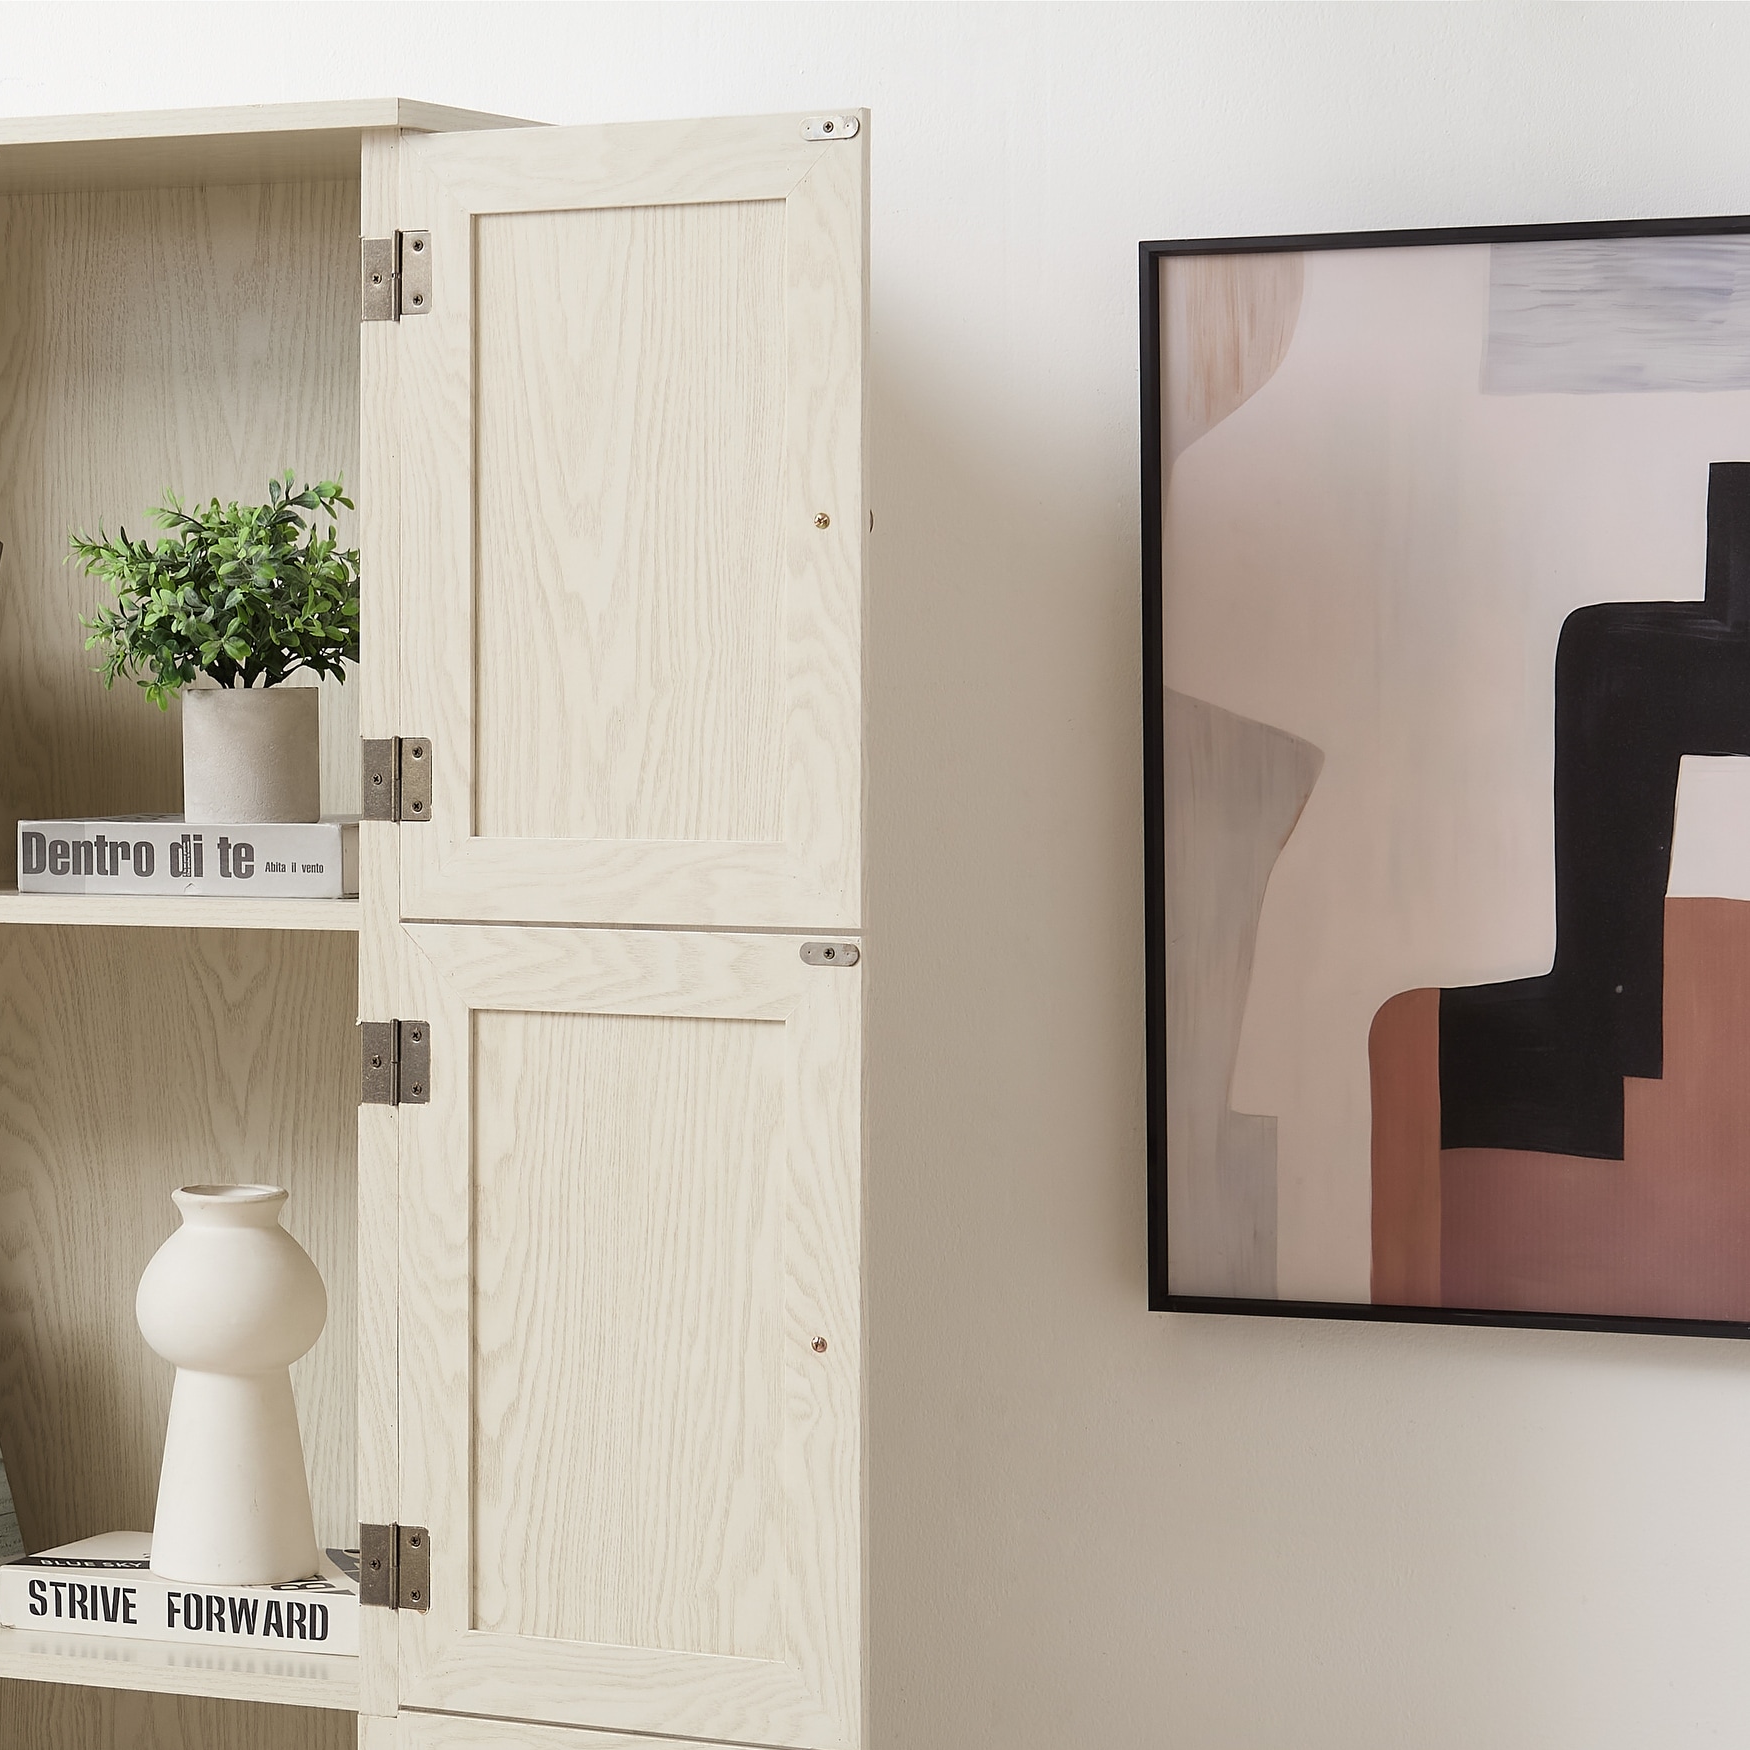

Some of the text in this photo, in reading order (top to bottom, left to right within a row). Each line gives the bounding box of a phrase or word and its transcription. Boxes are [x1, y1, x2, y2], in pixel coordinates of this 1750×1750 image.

[22, 831, 155, 878] Dentro
[169, 834, 204, 879] di
[217, 836, 255, 880] te
[264, 861, 324, 874] Abita il vento
[40, 1559, 96, 1567] BLUE
[28, 1579, 330, 1642] STRIVE FORWARD
